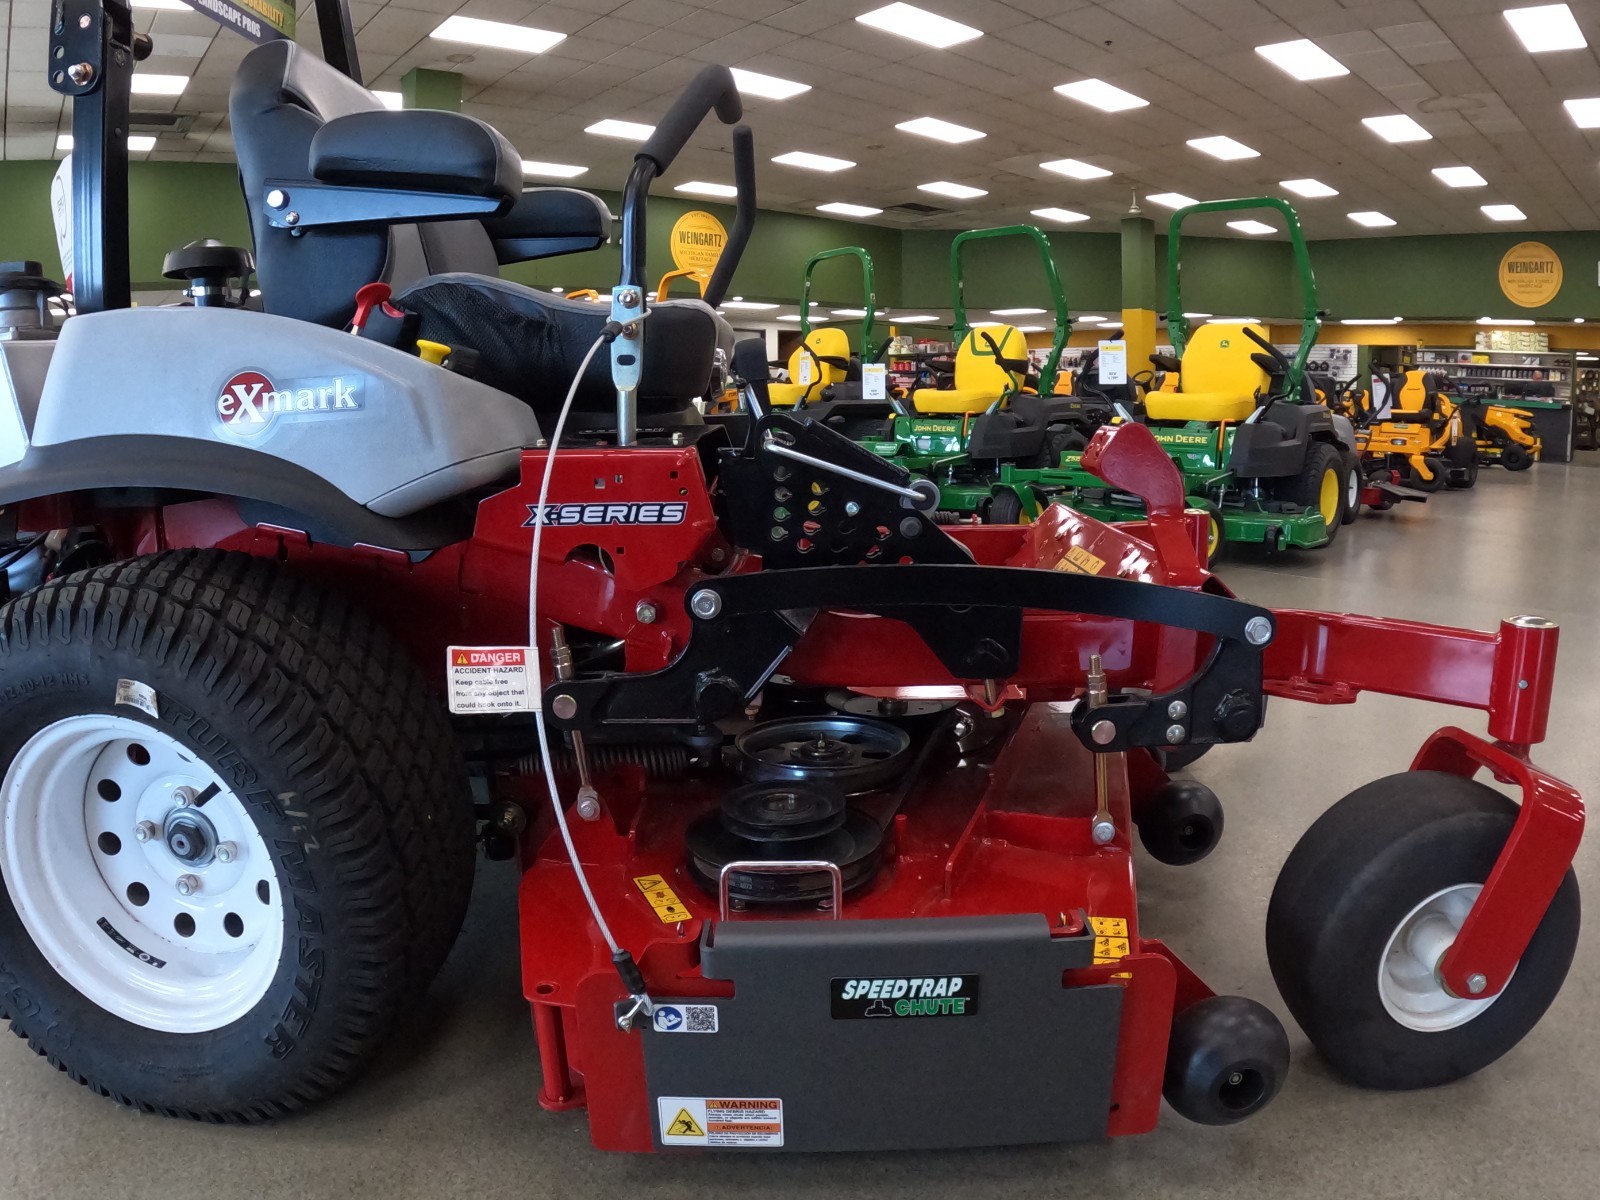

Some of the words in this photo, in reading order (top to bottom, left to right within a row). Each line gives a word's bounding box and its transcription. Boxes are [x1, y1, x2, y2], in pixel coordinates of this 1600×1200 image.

[242, 15, 261, 38] PROS
[679, 231, 722, 247] WEINGARTZ
[1507, 261, 1554, 274] WEINGARTZ
[913, 424, 932, 432] JOHN
[932, 424, 956, 432] DEERE
[1154, 434, 1174, 443] OHN
[1175, 434, 1208, 444] DEERE
[525, 504, 686, 525] X-SERIES
[470, 652, 521, 663] DANGER
[493, 666, 524, 674] HAZARD
[263, 838, 326, 1061] MASTER
[841, 977, 963, 1000] SPEEDTRAP
[894, 998, 965, 1016] CHUTE
[719, 1101, 777, 1109] WARNING
